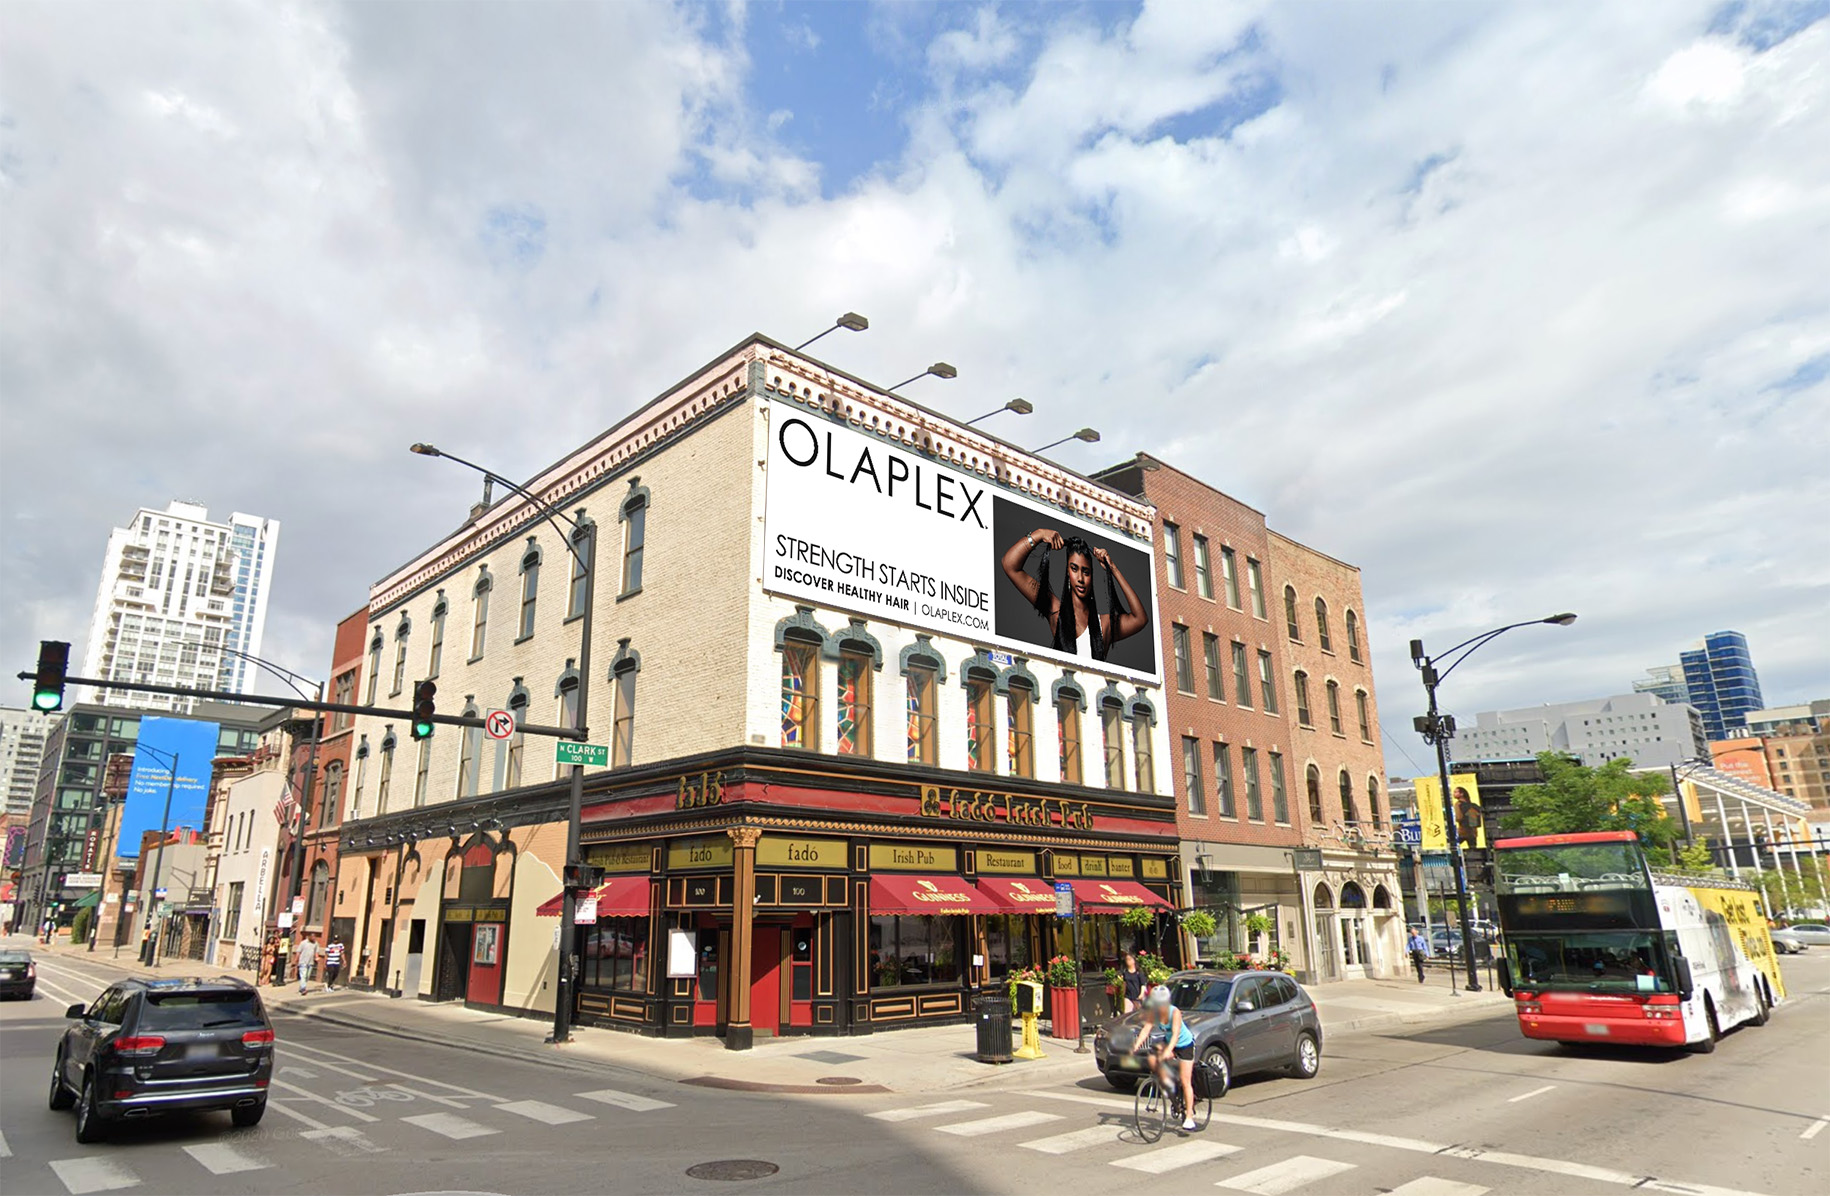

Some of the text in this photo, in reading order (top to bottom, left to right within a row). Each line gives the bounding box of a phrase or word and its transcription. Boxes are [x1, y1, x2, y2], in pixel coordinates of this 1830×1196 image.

[776, 534, 989, 612] STRENGTH STARTS INSIDE
[774, 565, 990, 631] DISCOVER HEALTHY HAIR OLAPLEX.COM
[567, 744, 596, 756] CLARK
[598, 748, 605, 756] ST
[949, 789, 1095, 830] fadó Irish Pub
[689, 845, 713, 863] fadó
[788, 843, 819, 862] fadó
[892, 848, 935, 864] Irish Pub
[986, 853, 1025, 868] Restaurant
[1058, 857, 1073, 871] food
[1111, 861, 1131, 873] banter
[792, 887, 806, 896] 100
[912, 891, 971, 903] GUINNESS
